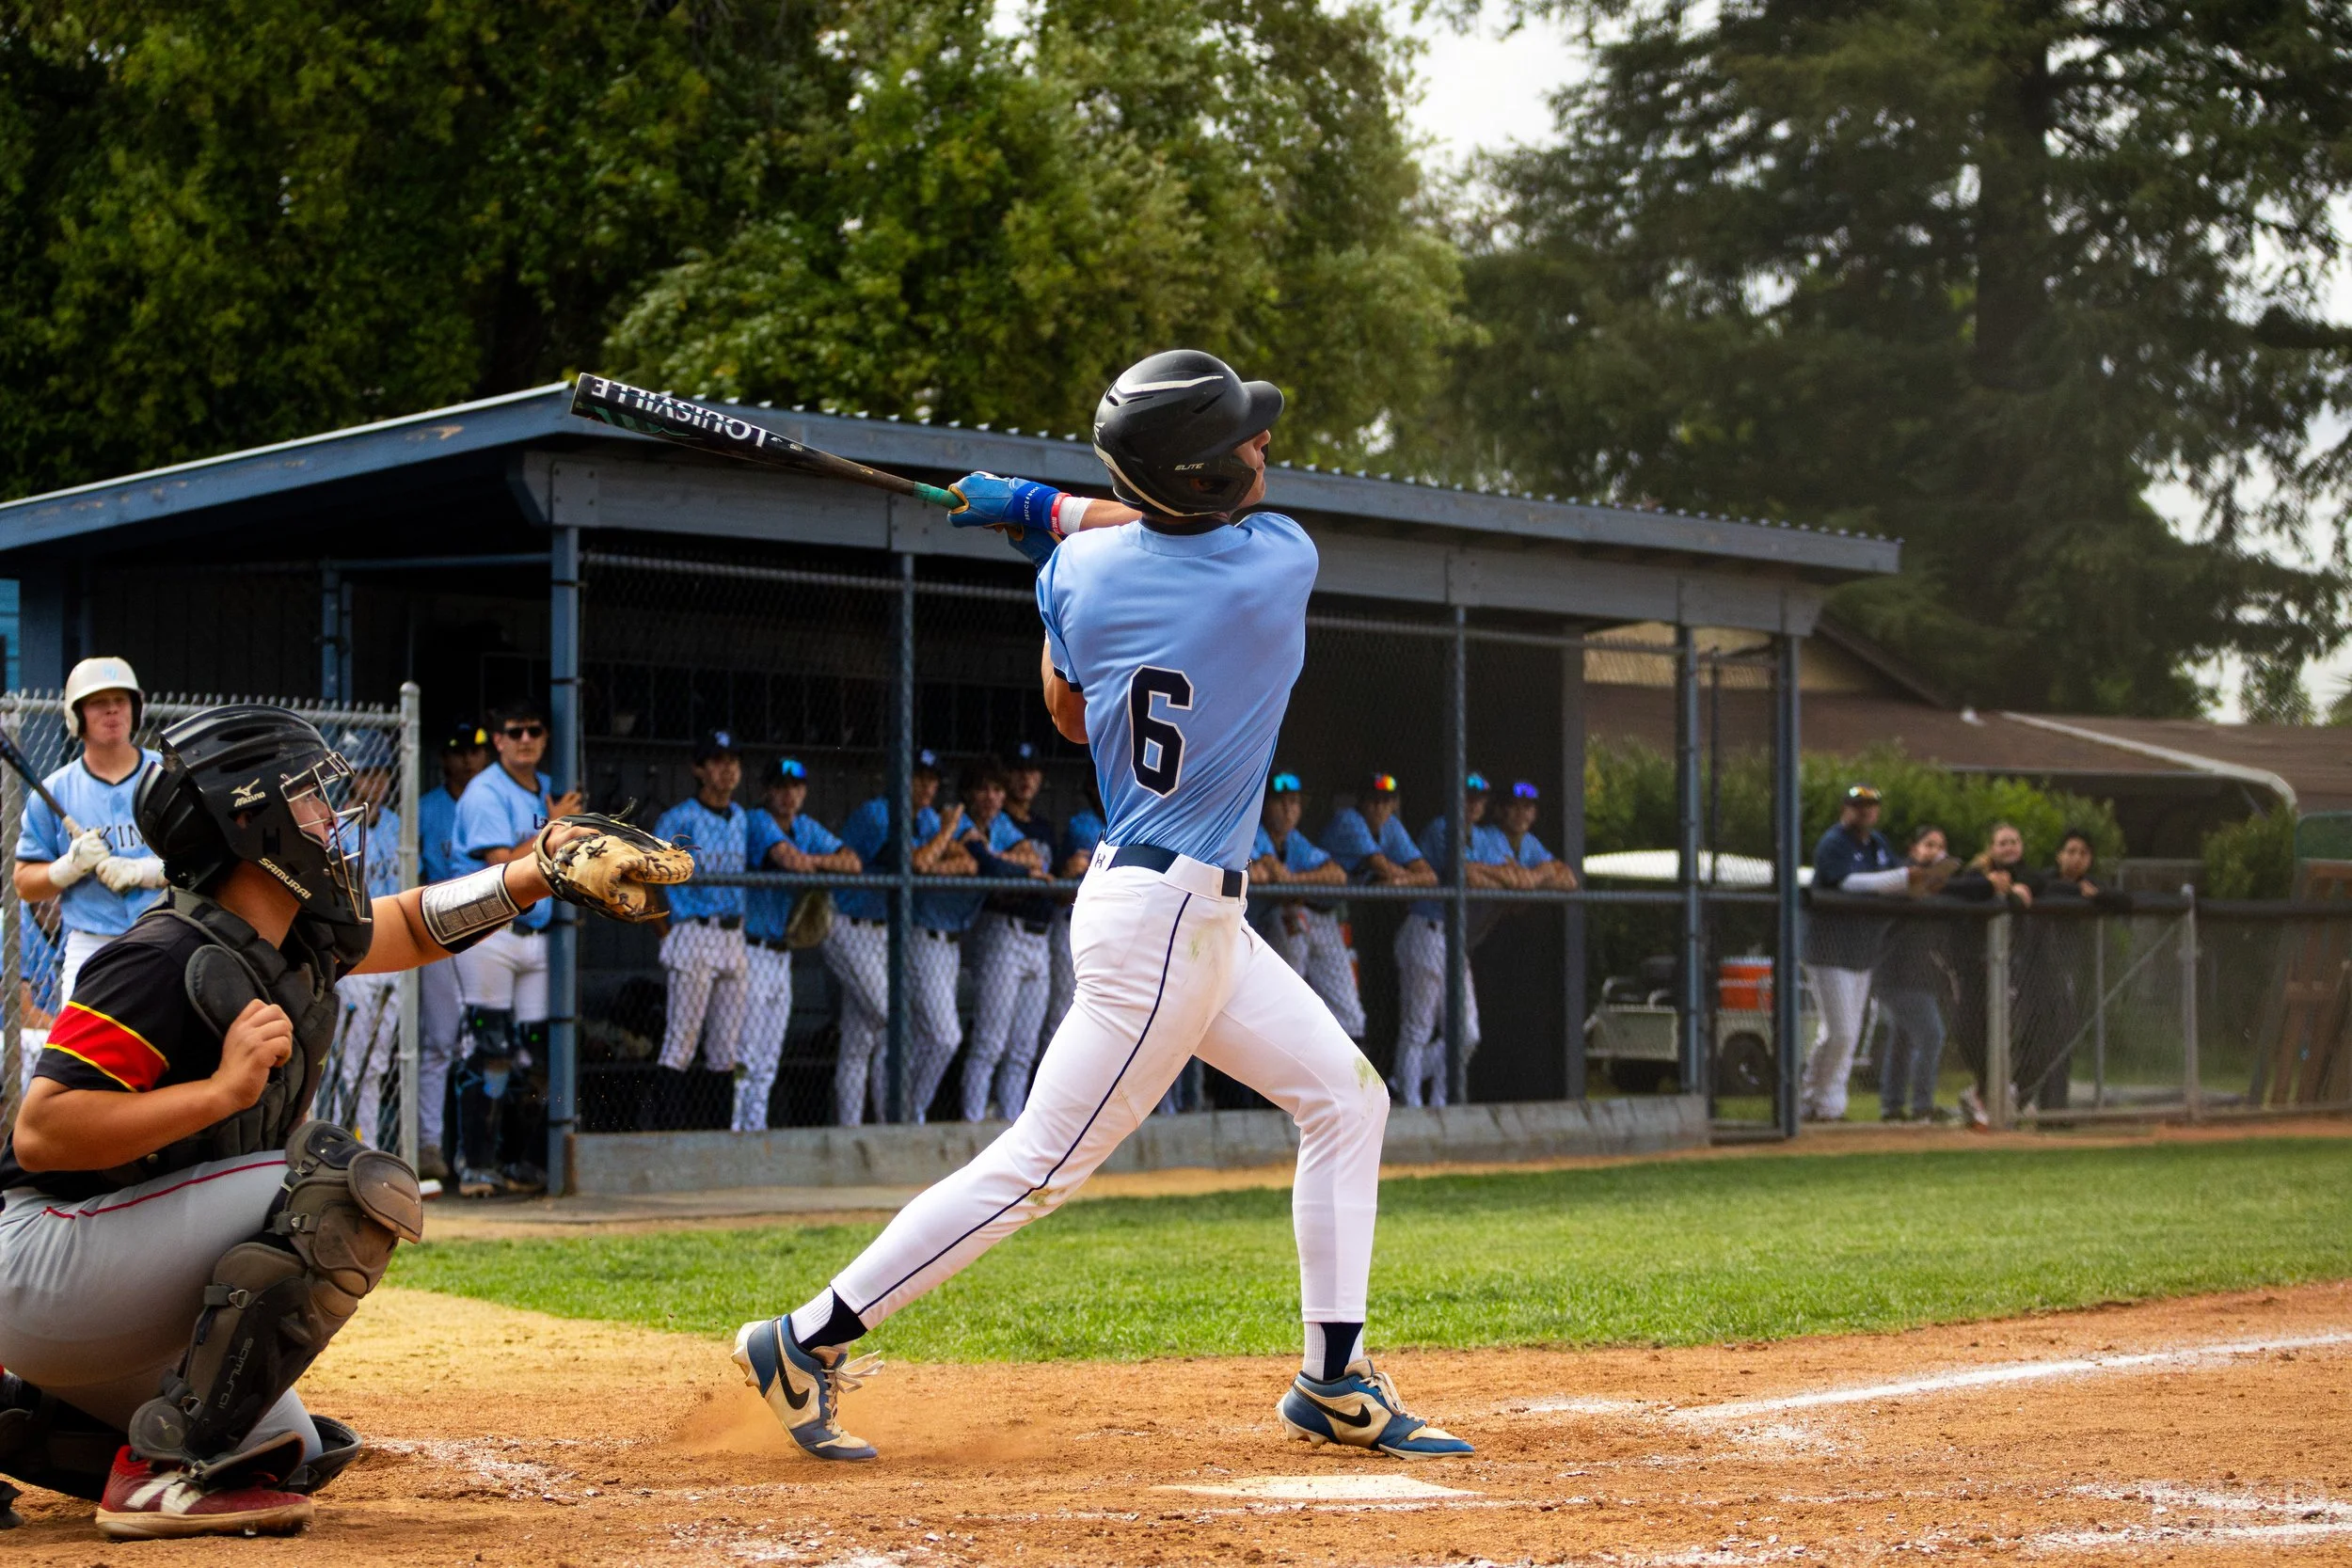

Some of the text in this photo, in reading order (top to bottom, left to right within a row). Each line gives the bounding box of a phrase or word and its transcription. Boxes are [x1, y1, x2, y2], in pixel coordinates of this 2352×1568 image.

[591, 376, 770, 449] LOUISVILLE
[1174, 462, 1205, 471] ELITE
[1127, 664, 1194, 799] 6
[258, 857, 313, 900] SAMURAI
